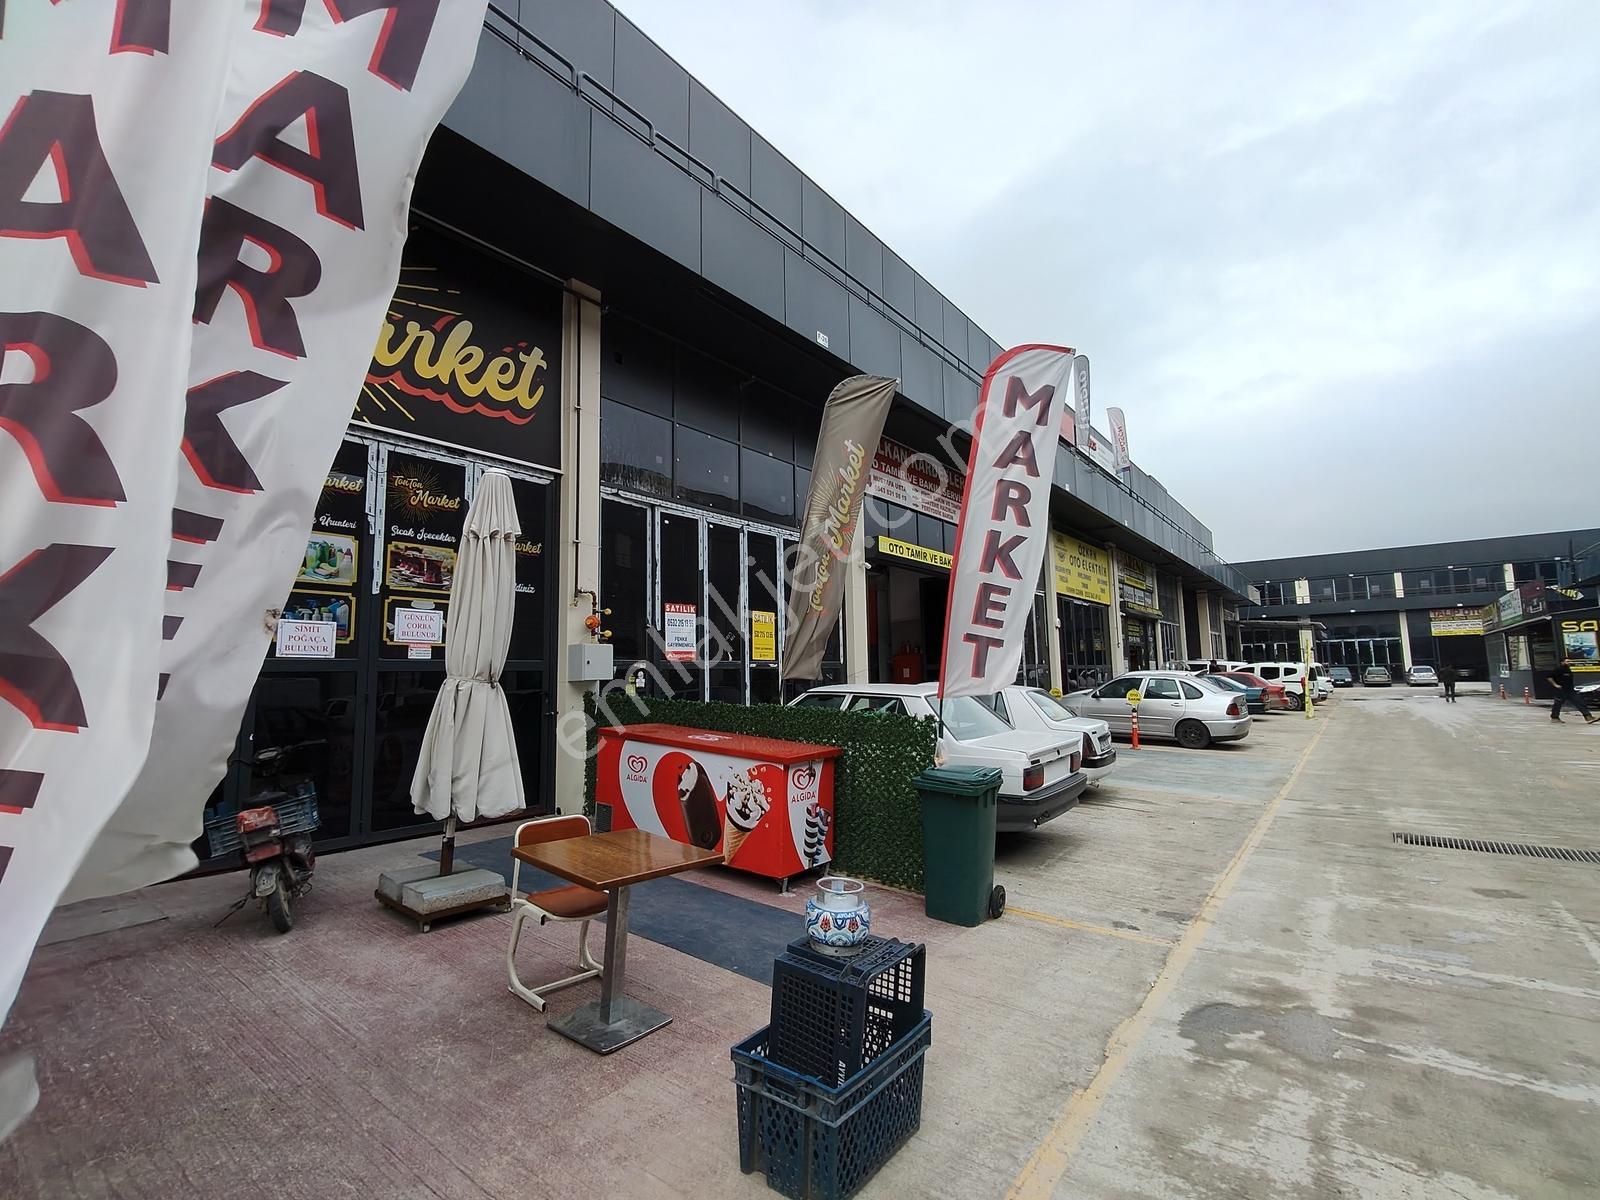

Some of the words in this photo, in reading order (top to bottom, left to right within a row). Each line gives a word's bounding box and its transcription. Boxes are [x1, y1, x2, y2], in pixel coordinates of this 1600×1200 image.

[878, 440, 907, 462] LKAN
[325, 476, 364, 492] arket
[410, 488, 461, 510] Market
[825, 439, 865, 550] Market
[963, 375, 1055, 679] MARKET
[515, 541, 542, 554] arket
[888, 542, 904, 555] OTO
[905, 546, 928, 561] TAMİR
[929, 553, 938, 564] VE
[939, 555, 953, 568] BAK
[1069, 554, 1081, 569] OTO
[515, 583, 536, 593] diniz
[665, 604, 696, 613] SATILIK
[404, 613, 436, 622] GÜNLÜK
[294, 624, 321, 633] SİMİT
[401, 630, 437, 638] BULUNUR
[288, 633, 327, 643] POĞAÇA
[284, 644, 329, 652] BULUNUR
